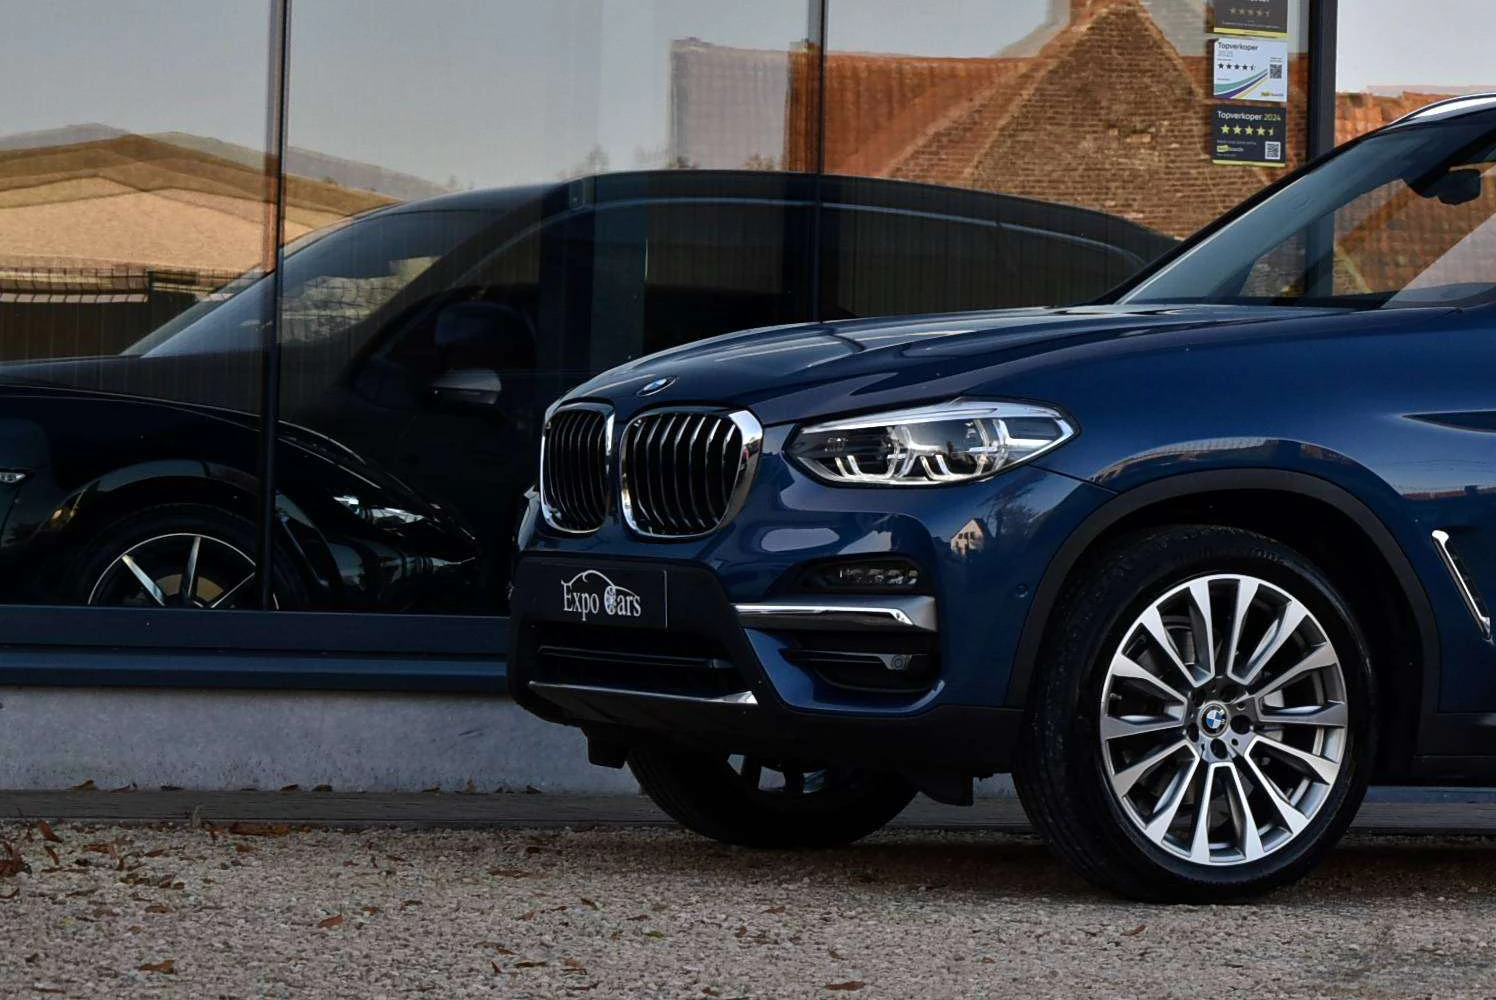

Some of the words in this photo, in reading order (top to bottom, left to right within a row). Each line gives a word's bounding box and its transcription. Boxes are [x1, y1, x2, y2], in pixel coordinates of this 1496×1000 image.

[1218, 42, 1259, 52] Topverkoper
[1217, 111, 1262, 121] Topverkoper
[1263, 112, 1281, 121] 2024
[561, 580, 600, 622] Expo
[604, 585, 642, 617] Cars
